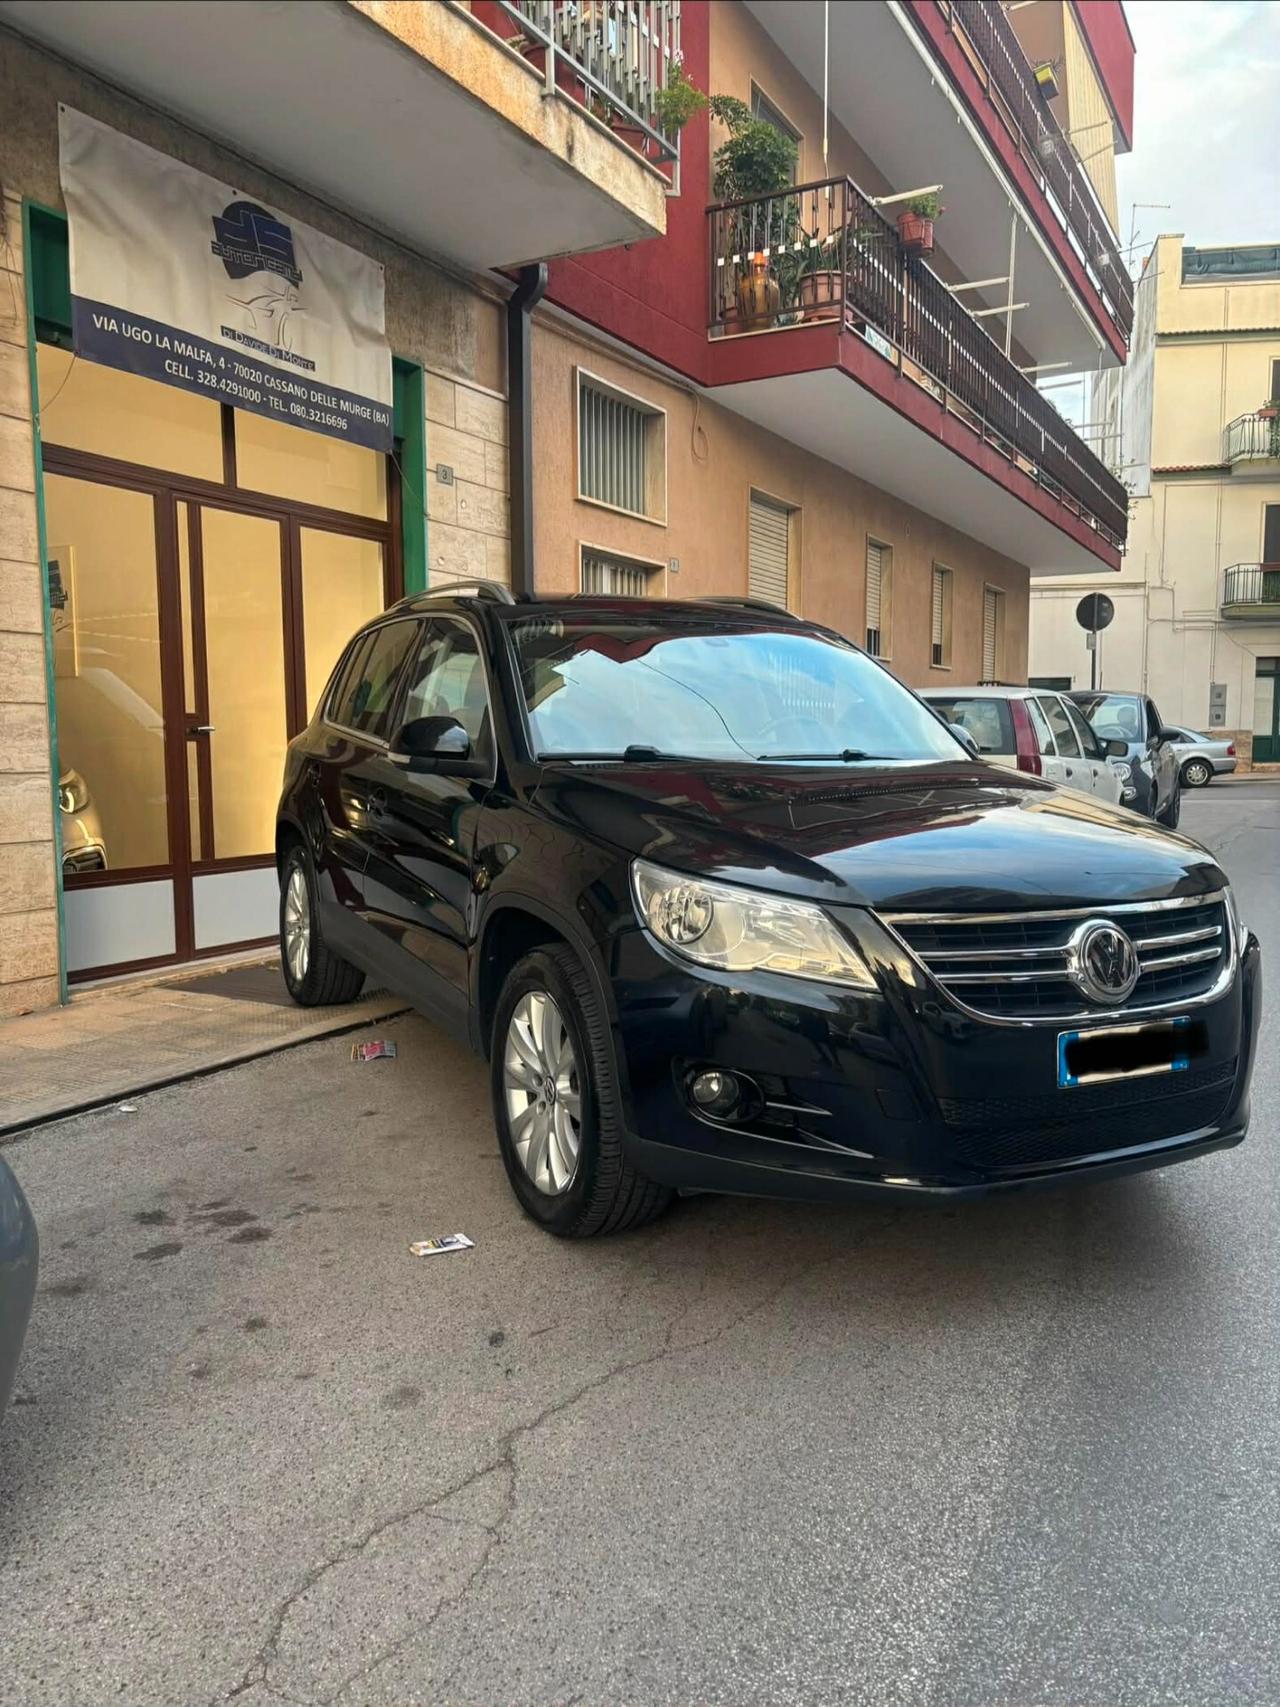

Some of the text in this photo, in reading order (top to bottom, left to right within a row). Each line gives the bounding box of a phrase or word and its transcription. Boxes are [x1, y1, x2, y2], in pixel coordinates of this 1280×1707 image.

[92, 314, 119, 334] VIA
[121, 322, 152, 344] UGO
[155, 330, 171, 351] LA
[174, 337, 216, 369] MALFA,
[218, 356, 226, 370] 4
[233, 361, 262, 384] 70020
[264, 375, 308, 399] CASSANO
[310, 390, 338, 409] DELLE
[340, 399, 372, 420] MURGE
[372, 409, 390, 426] (BA)
[164, 359, 193, 380] CELL.
[197, 369, 262, 404] 328.4291000
[268, 396, 288, 412] TEL.
[290, 402, 348, 430] 080.3216696
[442, 468, 448, 480] 3
